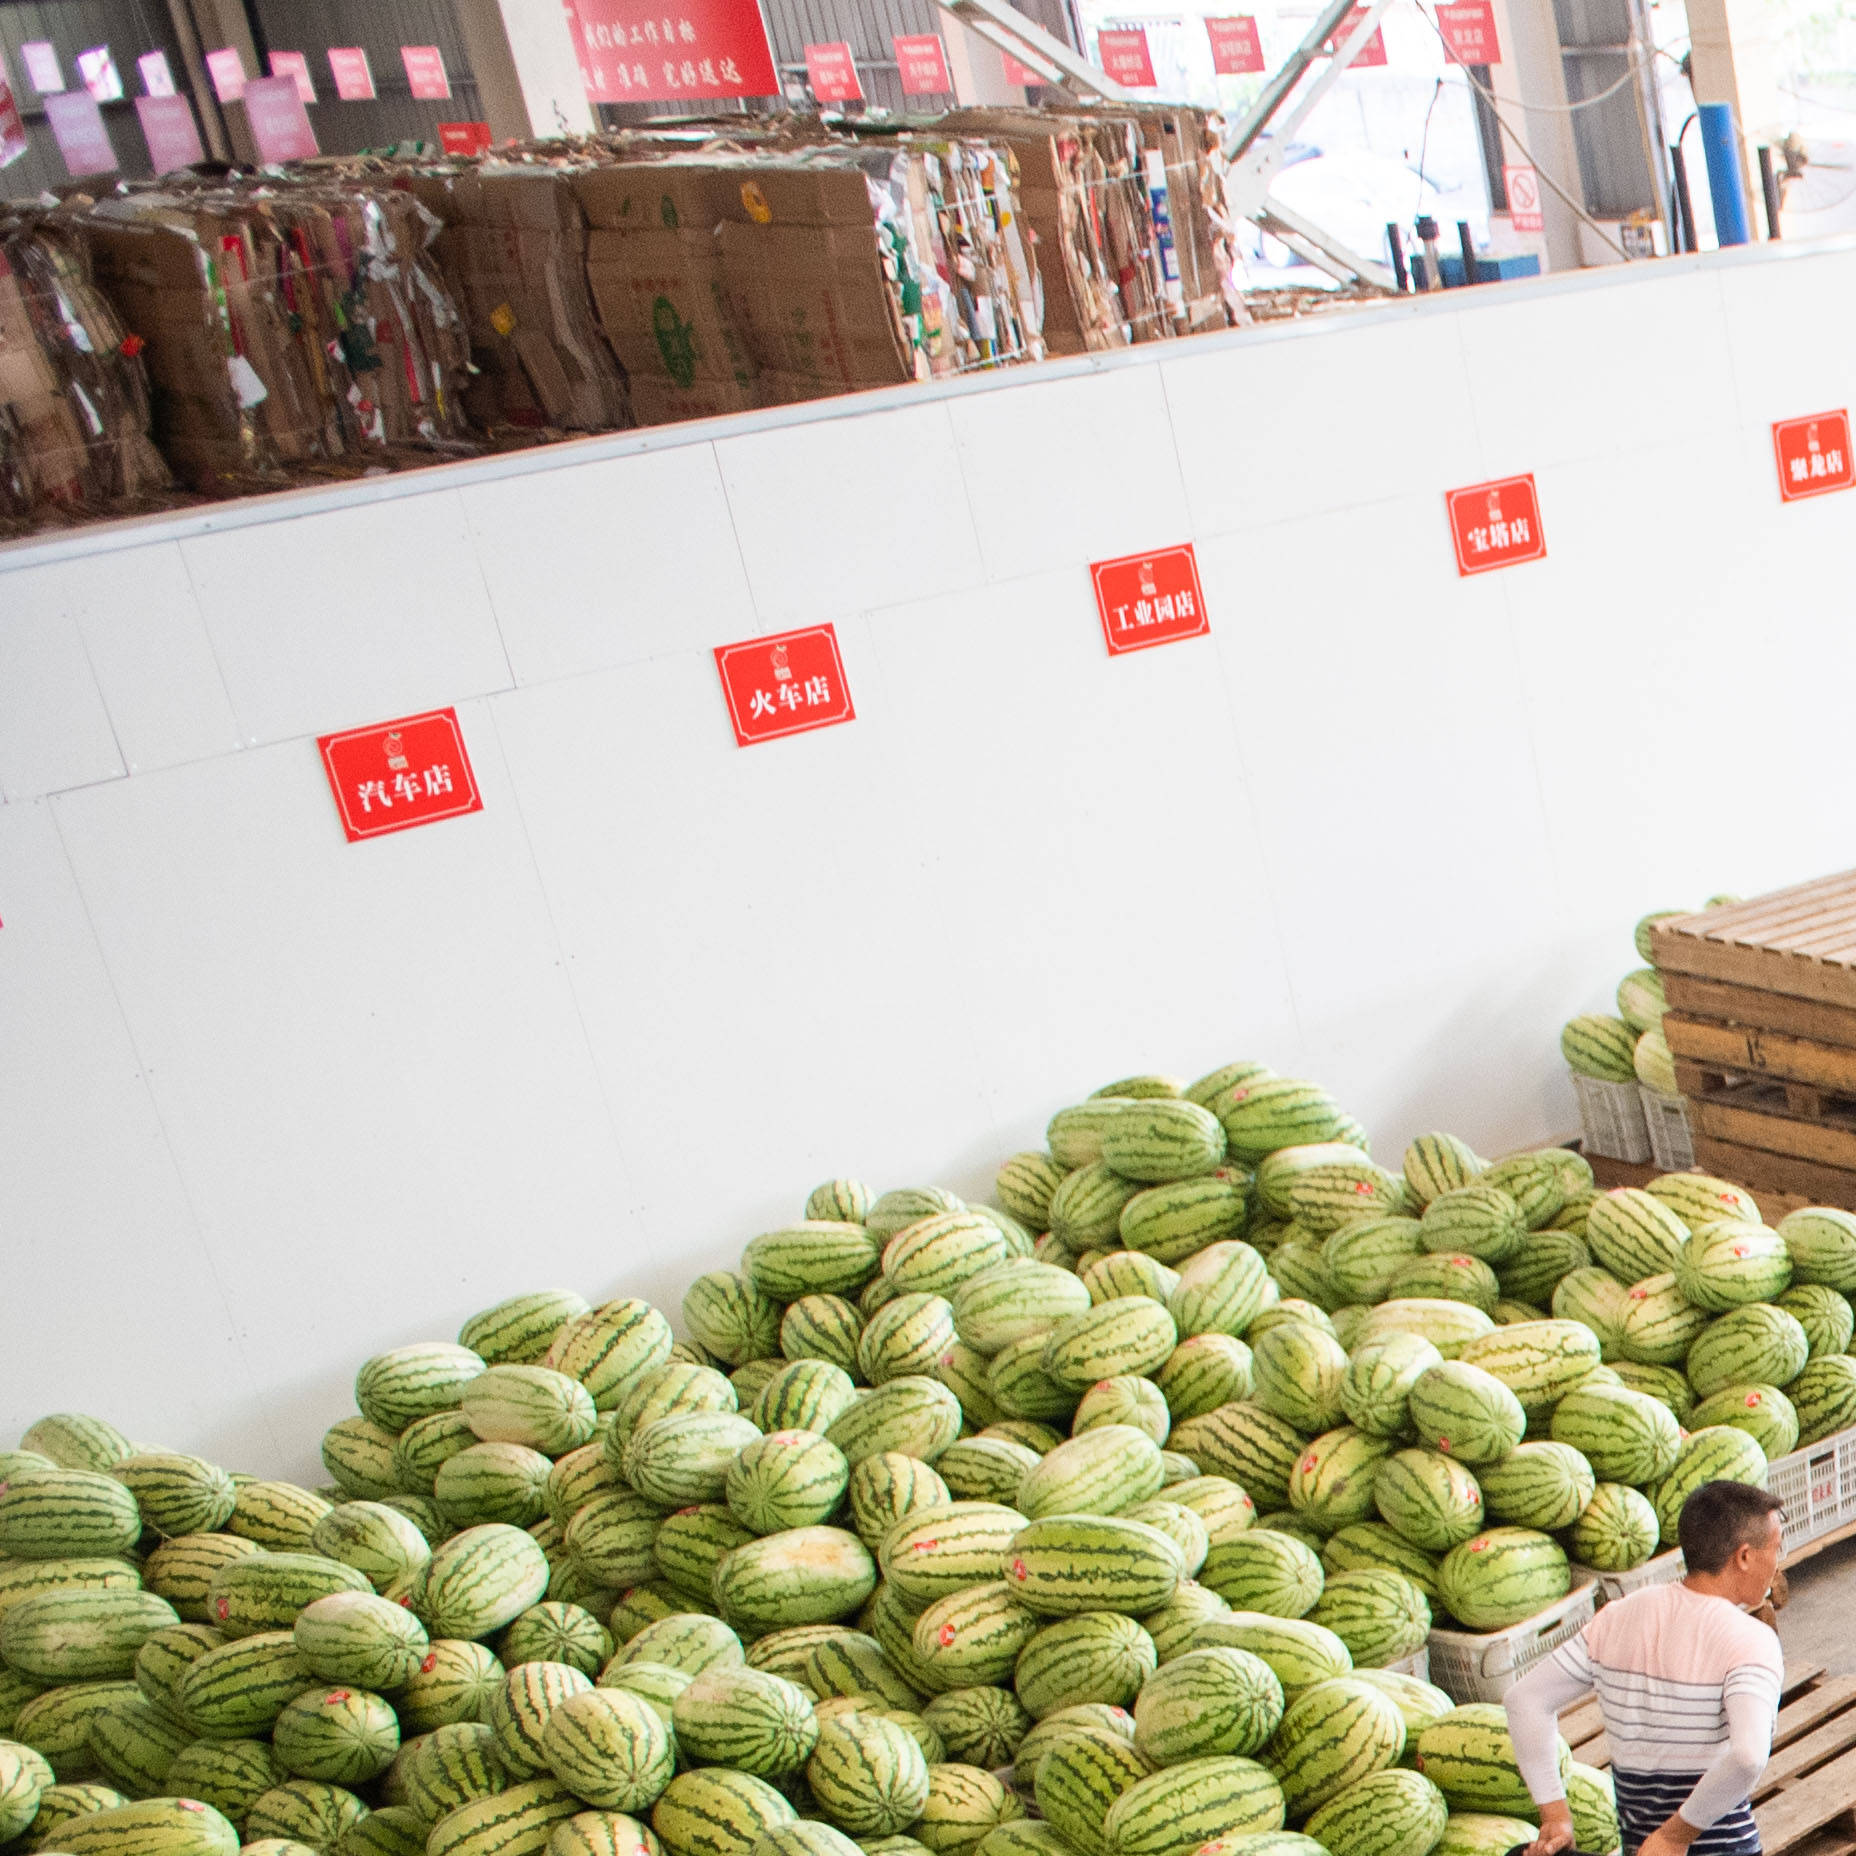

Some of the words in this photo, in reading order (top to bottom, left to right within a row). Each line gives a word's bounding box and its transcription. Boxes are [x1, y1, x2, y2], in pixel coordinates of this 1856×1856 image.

[750, 675, 831, 720] 火车店
[357, 764, 453, 813] 汽车店
